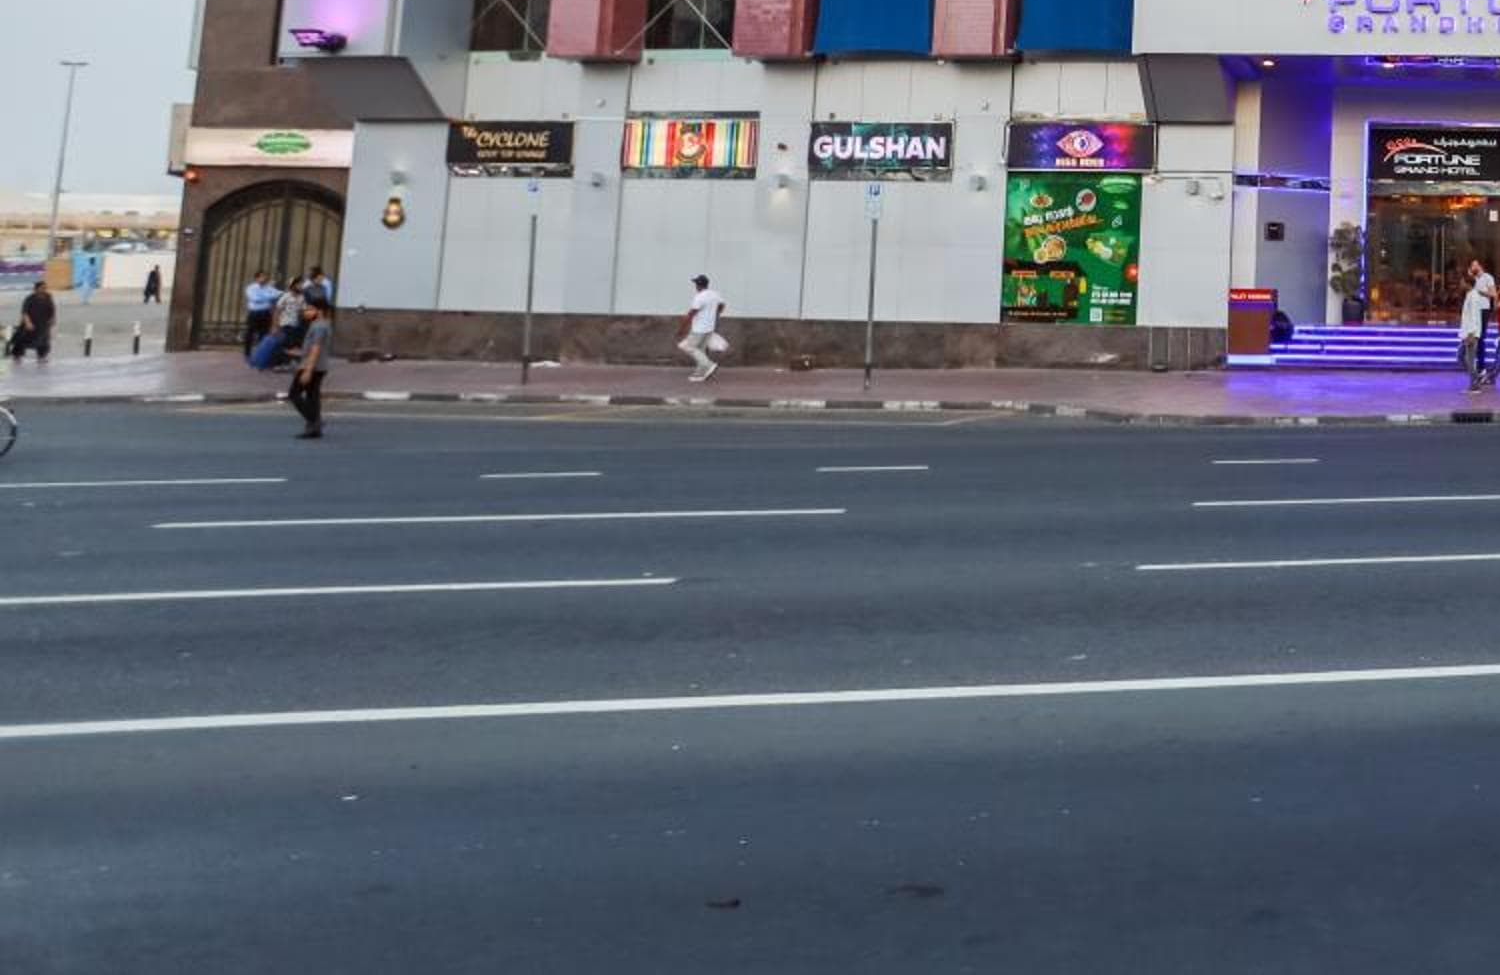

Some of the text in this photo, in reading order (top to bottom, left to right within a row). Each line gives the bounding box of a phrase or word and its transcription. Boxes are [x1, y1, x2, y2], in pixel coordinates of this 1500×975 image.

[476, 130, 552, 148] CYCLONE
[813, 135, 946, 161] GULSHAN
[1393, 154, 1480, 166] FORTUNE
[1393, 166, 1480, 176] GRAND HOTEL
